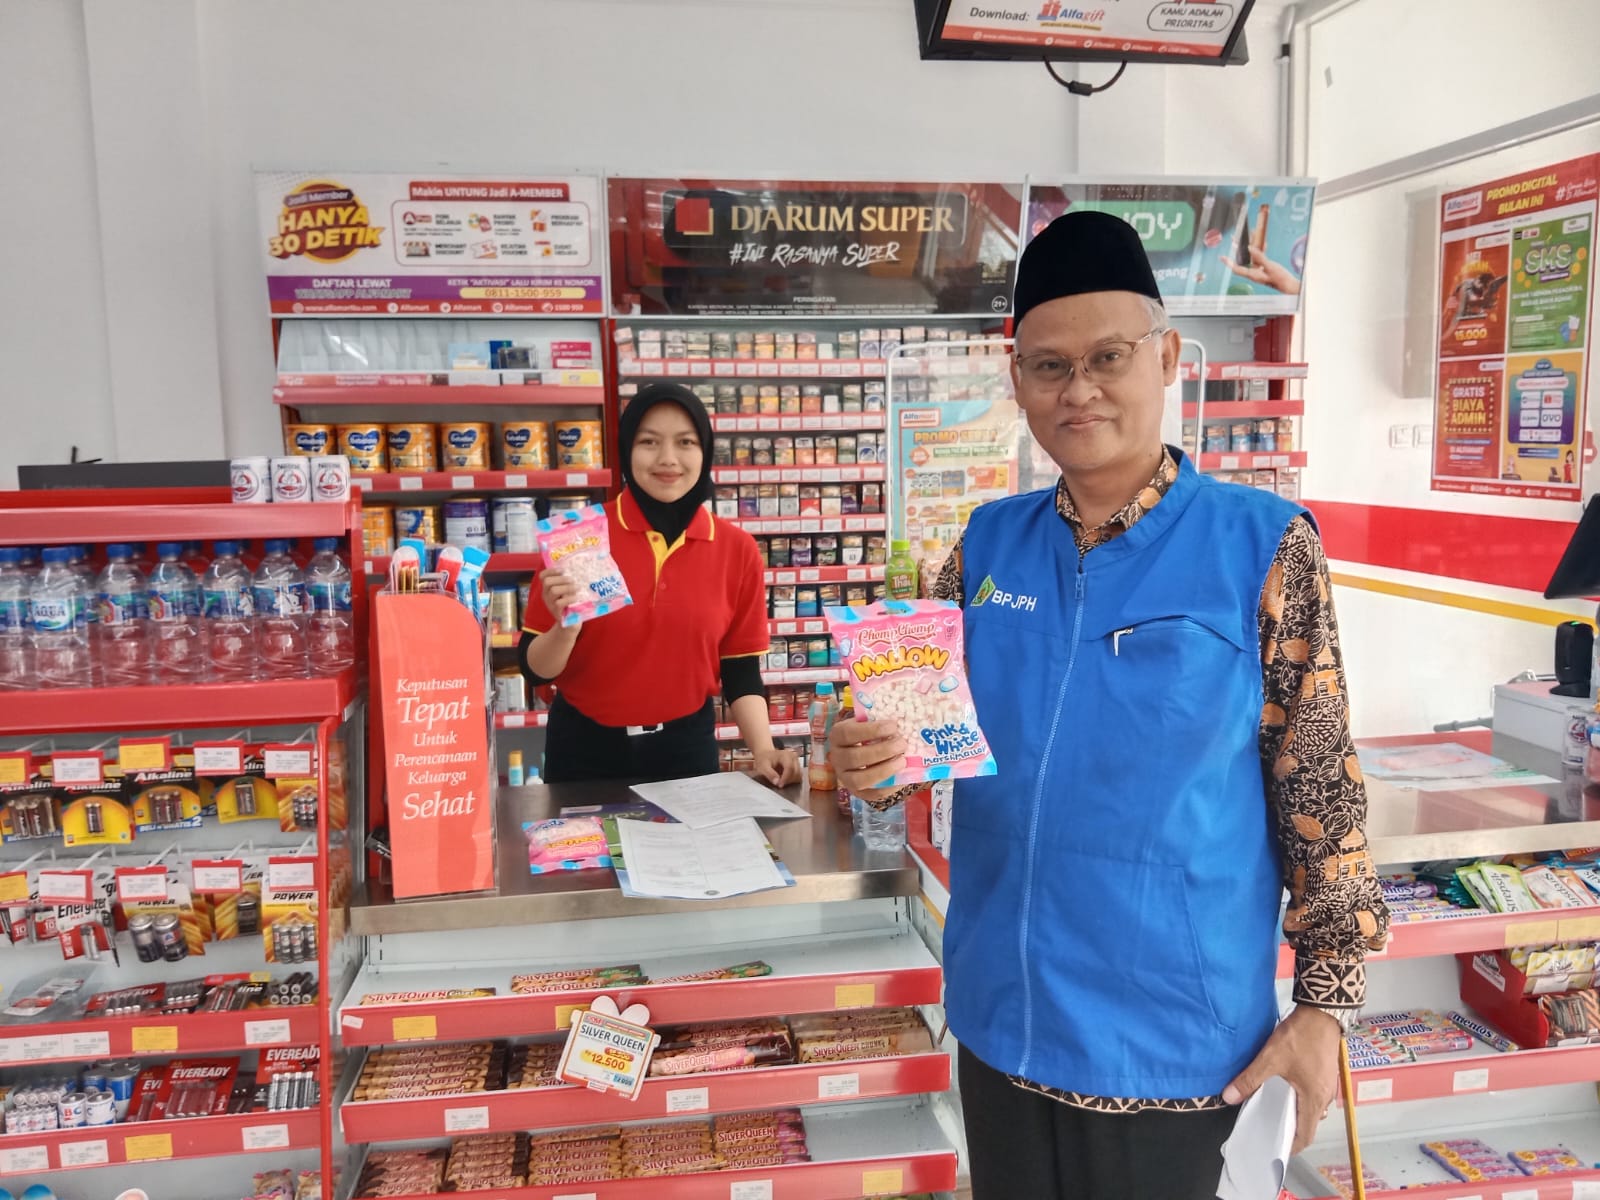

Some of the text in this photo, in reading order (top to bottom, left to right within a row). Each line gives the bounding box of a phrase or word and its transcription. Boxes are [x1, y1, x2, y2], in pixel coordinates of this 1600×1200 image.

[970, 7, 1105, 23] Download: Alfagift
[1160, 8, 1224, 18] KAMU ADALAH
[1164, 19, 1214, 29] PRIORITAS
[412, 187, 443, 198] Makin
[444, 188, 488, 199] UNTUNG
[510, 188, 564, 199] A-MEMBER
[1486, 174, 1559, 202] PROMO DIGITAL
[1497, 198, 1529, 215] BULAN
[279, 206, 369, 234] HANYA
[730, 204, 955, 234] DJARUM SUPER
[269, 226, 386, 257] 30 DETIK
[841, 240, 902, 269] SUPER
[1524, 243, 1573, 275] SMS
[312, 279, 392, 288] DAFTAR LEWAT
[1452, 386, 1486, 398] GRATIS
[1452, 398, 1486, 411] BIAYA
[1451, 412, 1487, 425] ADMIN
[913, 430, 958, 444] PROMO
[991, 589, 1038, 612] BPJPH
[852, 645, 951, 682] MALLOW
[396, 677, 469, 696] Keputusan
[397, 695, 472, 732] Tepat
[413, 731, 458, 748] Untuk
[920, 724, 959, 745] Pink
[935, 731, 980, 756] White
[394, 751, 478, 768] Perencanaan
[134, 771, 193, 783] Alkaline
[407, 769, 467, 786] Keluarga
[402, 788, 477, 822] Sehat
[273, 892, 314, 901] POWER
[517, 969, 593, 982] SILVERQUEEN
[367, 990, 447, 1002] SILVERQUEEN
[523, 981, 601, 994] SILVERQUEEN
[1452, 1011, 1494, 1039] mentos
[580, 1024, 646, 1052] SILVER QUEEN
[266, 1045, 320, 1061] EVEREADY
[813, 1042, 859, 1058] SILVERQUEEN
[591, 1053, 625, 1071] 12.500
[172, 1066, 231, 1079] EVEREADY
[718, 1127, 775, 1144] SILVERQUEEN
[537, 1163, 609, 1176] SILVERQUEEN
[642, 1153, 716, 1171] SILVERQUEEN
